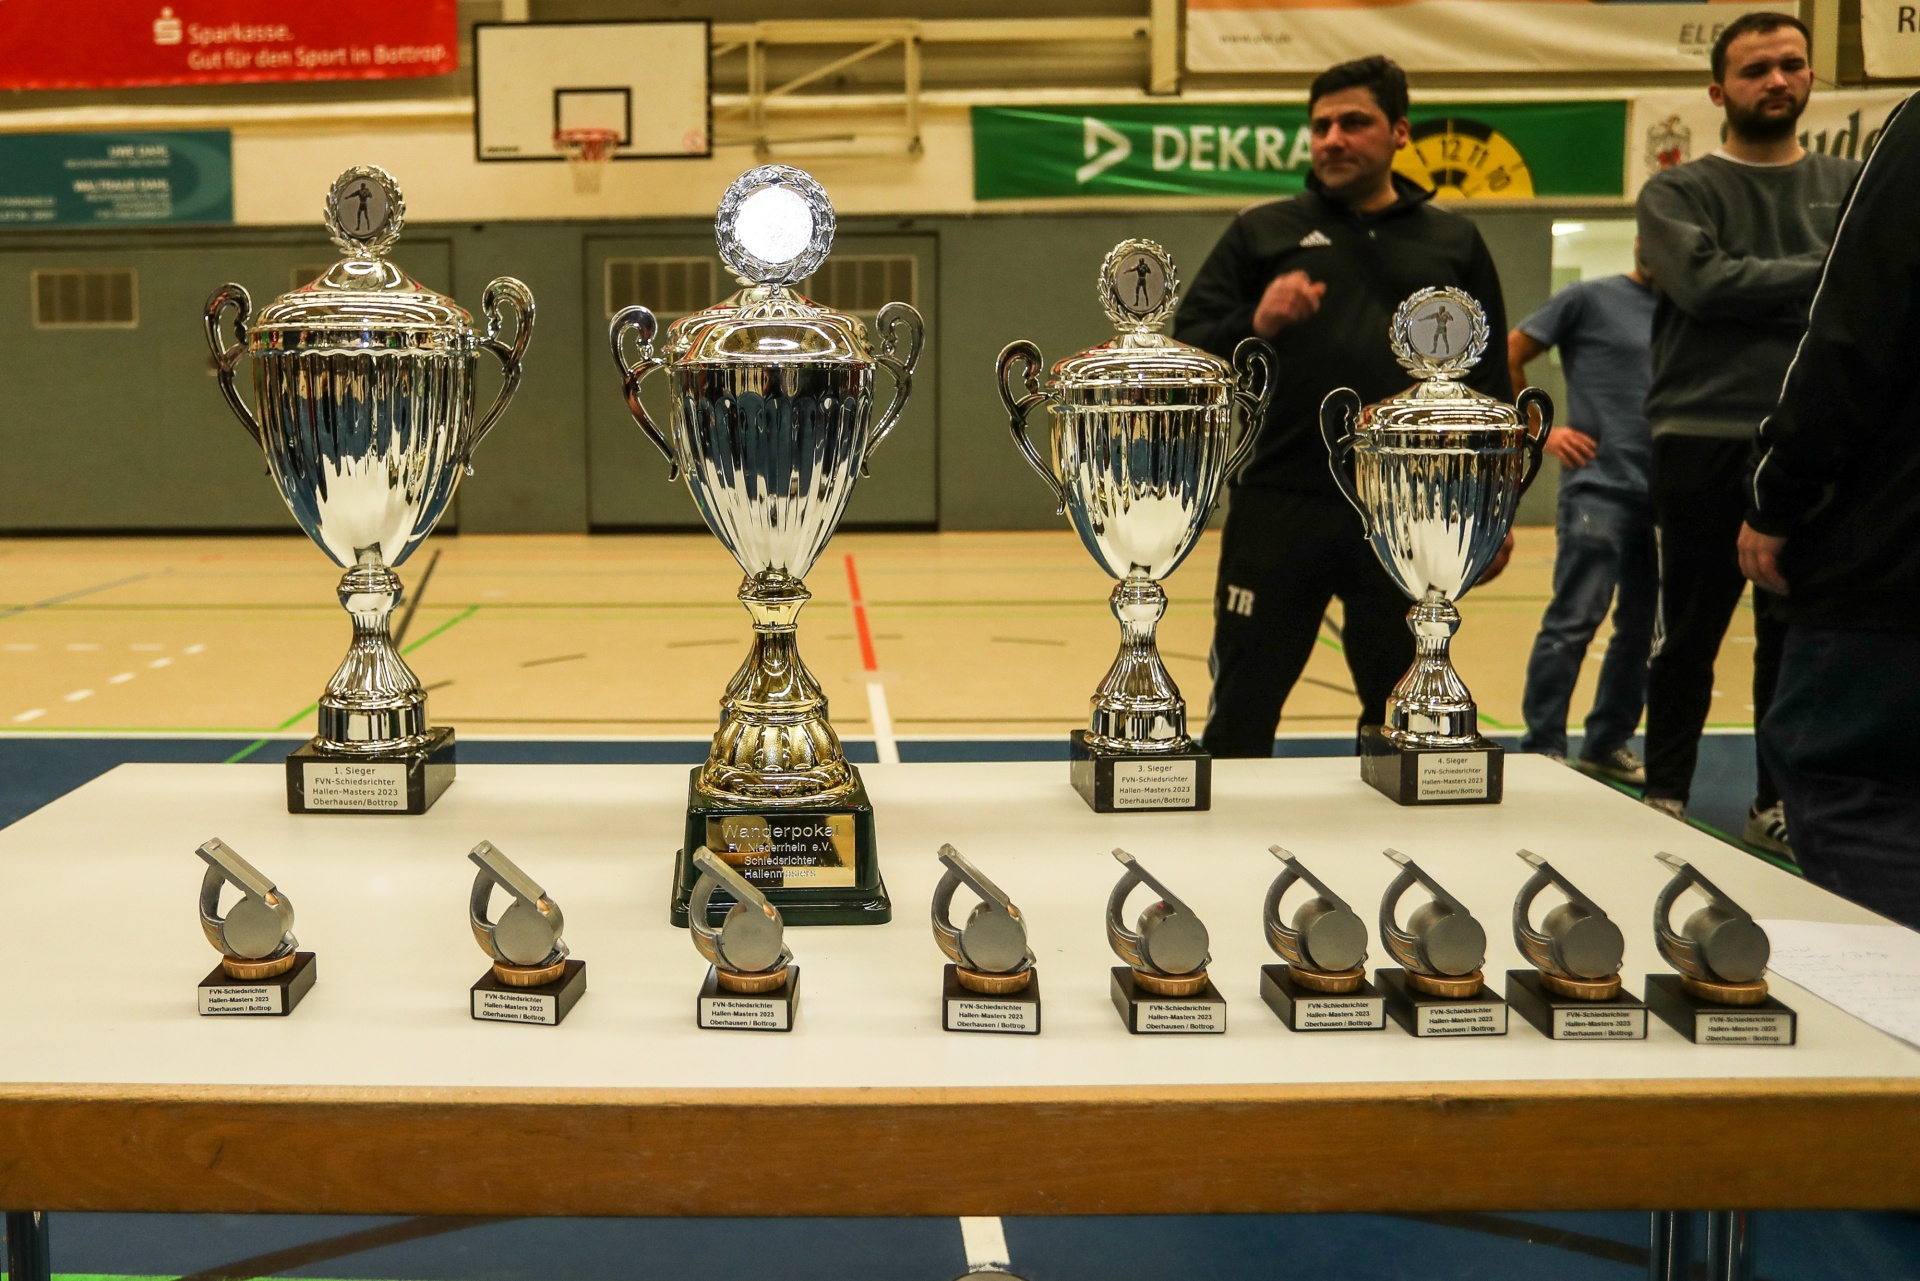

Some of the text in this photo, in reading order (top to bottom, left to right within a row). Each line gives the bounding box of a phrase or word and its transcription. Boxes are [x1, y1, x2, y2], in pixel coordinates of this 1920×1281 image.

[187, 23, 294, 47] Sparkasse.
[187, 51, 221, 70] Gut
[224, 48, 251, 68] für
[254, 48, 292, 67] den
[295, 46, 346, 69] Sport
[351, 45, 371, 64] in
[1441, 138, 1461, 160] 12
[1226, 584, 1256, 617] TR
[1437, 757, 1468, 766] 4. Sieger
[334, 766, 376, 776] 1. Sieger
[1138, 764, 1173, 774] 3. Sieger
[1424, 767, 1481, 775] FVN-Schiedsrichter
[315, 777, 396, 786] FVN-Schiedsrichter
[1121, 775, 1188, 783] FVN-Schiedsrichter
[312, 788, 398, 796] Hallen-Masters 2023
[1119, 786, 1171, 794] Hallen-Masters
[1422, 787, 1483, 796] Oberhausen/Bottrop
[313, 798, 399, 807] Oberhausen/Bottrop
[1119, 796, 1190, 805] Oberhausen/Bottrop
[722, 824, 839, 841] Wanderpokal
[728, 842, 832, 853] FV Niederrhein e.V.
[744, 856, 817, 867] Schiedsrichter
[744, 868, 816, 880] Hallenmasters
[485, 993, 542, 1003] FVN-Schiedsrichter
[484, 1002, 528, 1011] Hallen-Masters
[712, 1001, 773, 1009] FVN-Schiedsrichter
[959, 1003, 1022, 1011] FVN-Schiedsrichter
[1430, 1007, 1492, 1015] FVN-Schiedsrichter
[482, 1010, 519, 1019] Oberhausen
[523, 1013, 546, 1022] Bottrop
[1001, 1022, 1026, 1030] Bottrop
[1189, 1023, 1215, 1031] Bottrop
